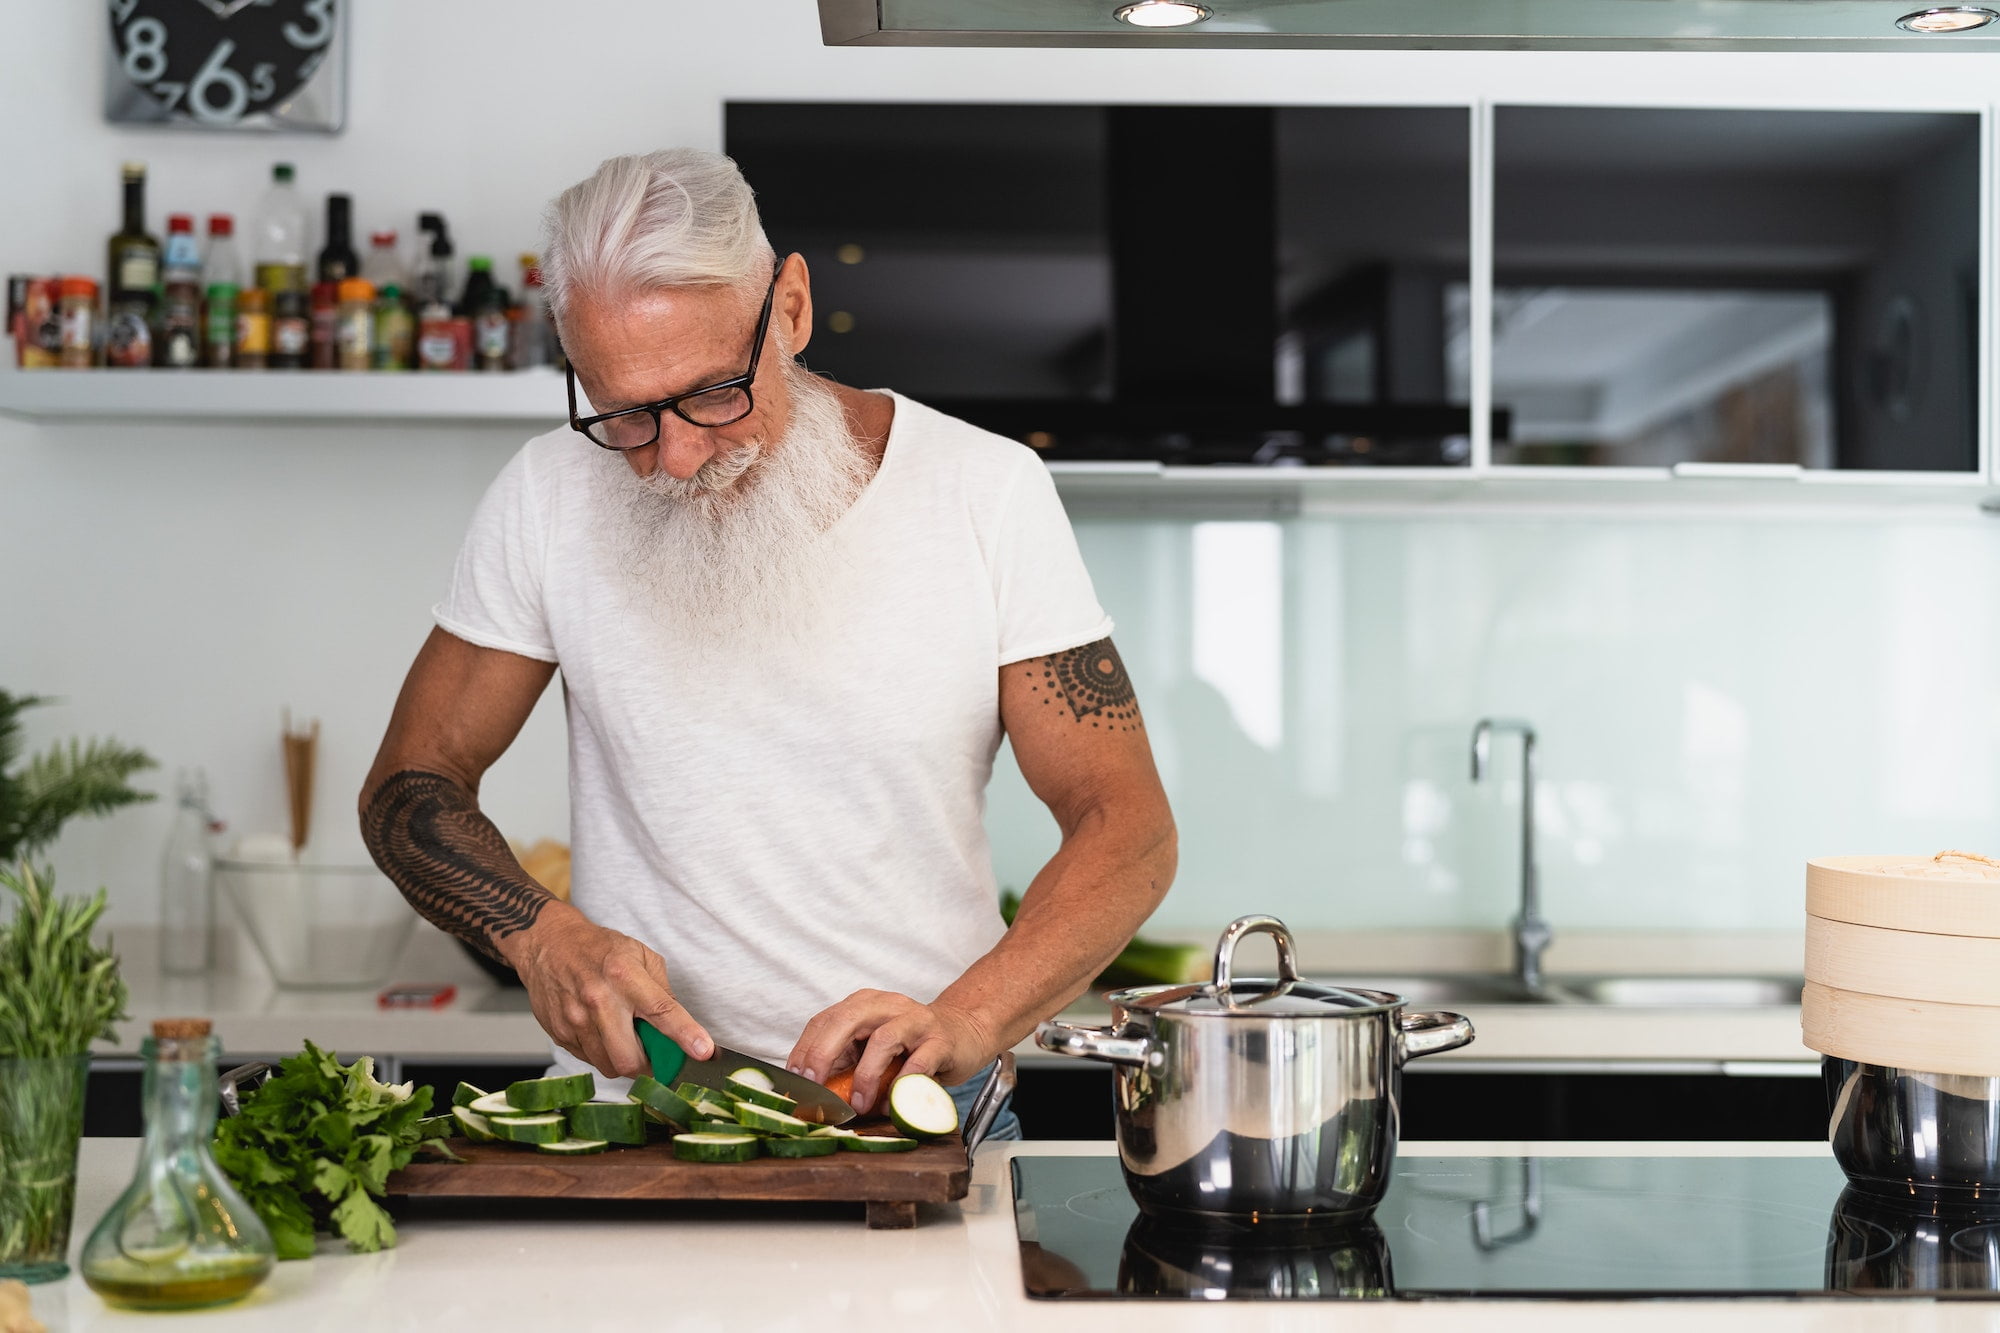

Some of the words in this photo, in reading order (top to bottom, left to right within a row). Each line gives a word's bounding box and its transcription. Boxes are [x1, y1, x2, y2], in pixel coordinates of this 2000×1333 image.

[281, 0, 335, 48] 3
[124, 16, 168, 83] 8
[153, 82, 186, 111] 7
[189, 39, 249, 122] 6
[249, 62, 276, 101] 5
